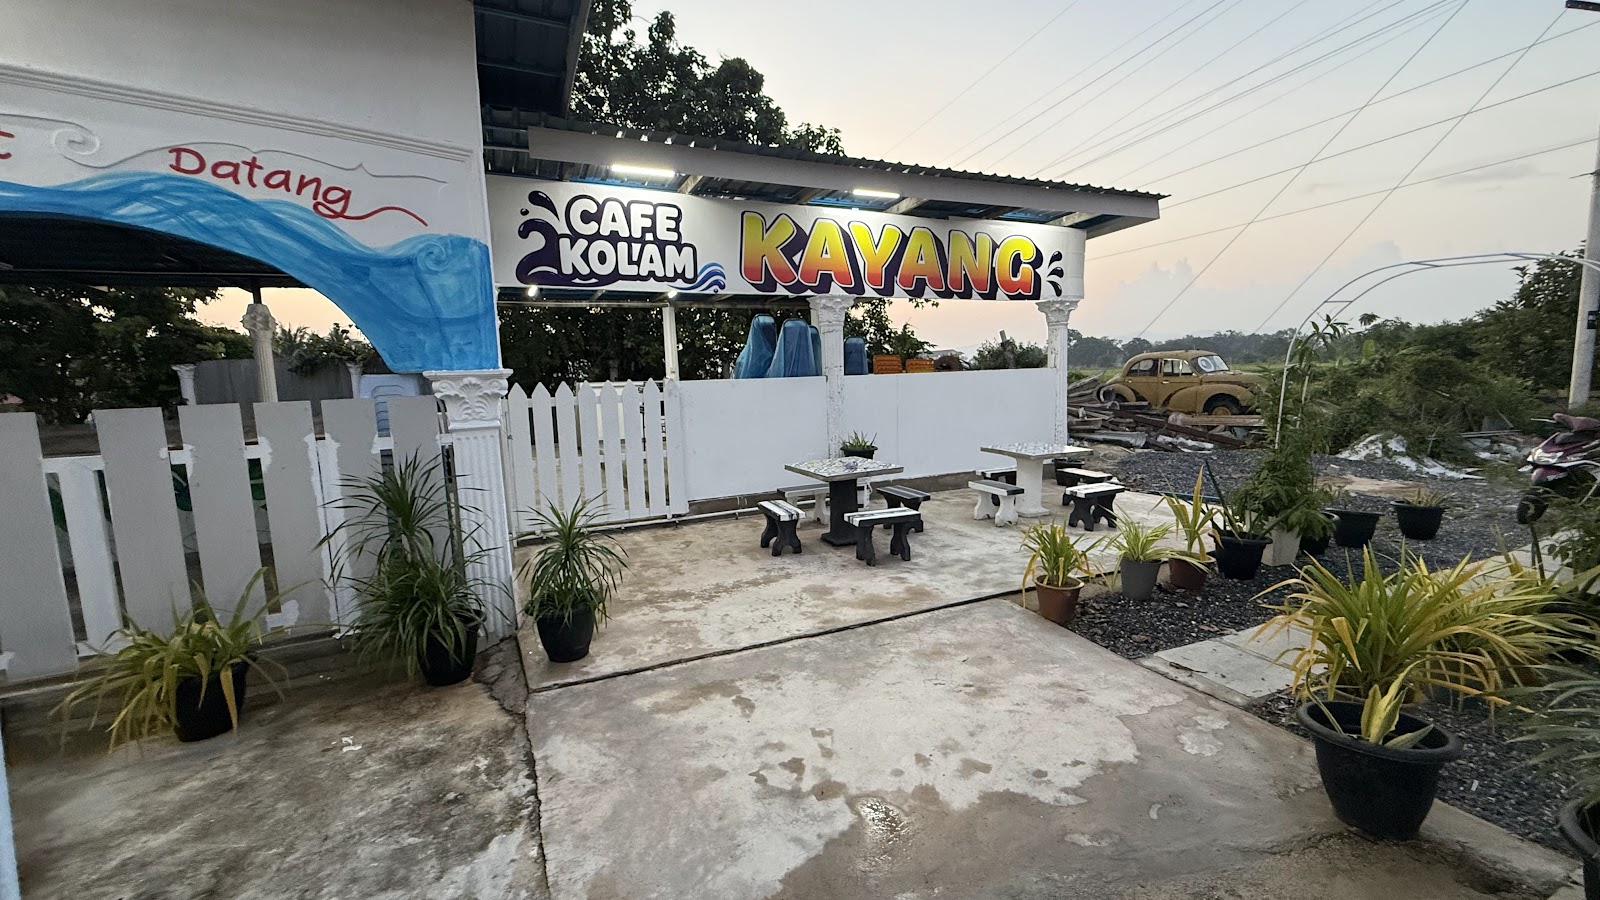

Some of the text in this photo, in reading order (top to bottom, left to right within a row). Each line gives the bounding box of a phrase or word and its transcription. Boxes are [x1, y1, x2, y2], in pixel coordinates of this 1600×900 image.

[168, 146, 428, 226] Datang
[567, 197, 680, 241] CAFE
[558, 237, 696, 281] KOLAM
[741, 211, 1042, 299] KAYANG
